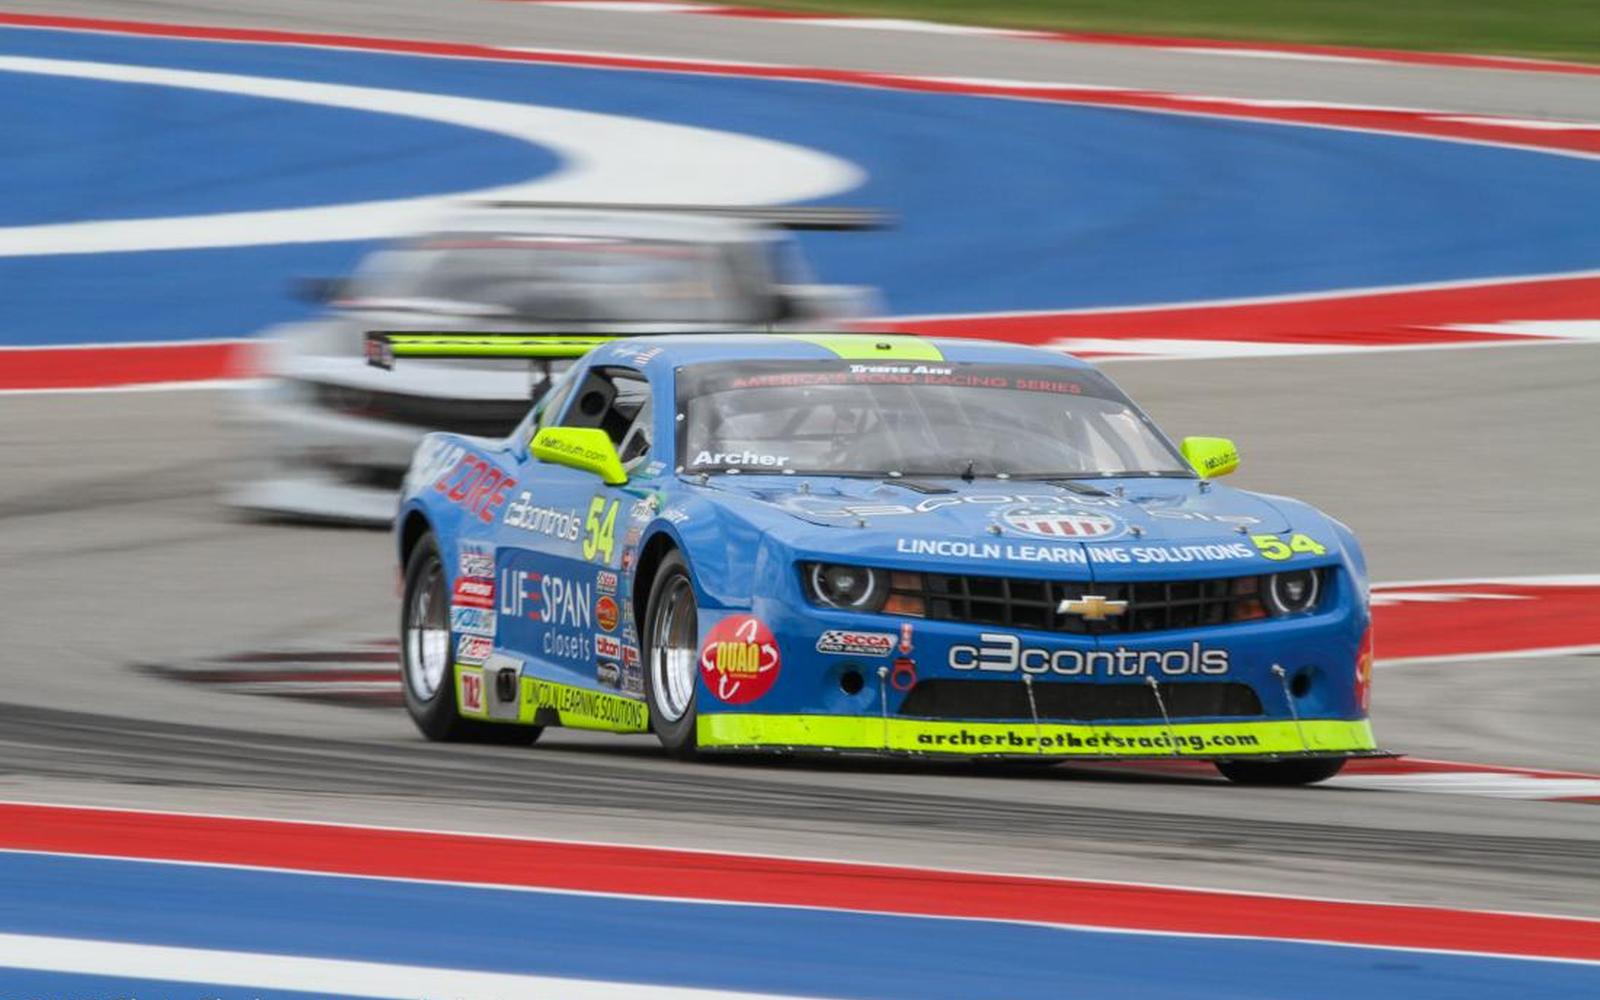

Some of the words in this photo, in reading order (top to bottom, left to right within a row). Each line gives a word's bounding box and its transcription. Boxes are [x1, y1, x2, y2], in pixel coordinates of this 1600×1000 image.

[849, 364, 903, 375] Trans
[907, 364, 953, 375] Am
[732, 374, 847, 388] AMERICA'S
[856, 374, 918, 385] ROAD
[923, 375, 1008, 388] RACING
[1016, 379, 1082, 395] SERIES
[692, 450, 789, 468] Archer
[582, 496, 620, 564] 54
[897, 538, 1000, 559] LINCOLN
[1005, 545, 1129, 564] LEARNING
[1131, 543, 1255, 563] SOLUTIONS
[1250, 534, 1327, 561] 54
[543, 628, 591, 662] closets
[820, 643, 844, 651] PRO
[843, 634, 890, 646] SCCA
[716, 641, 760, 675] QUAD
[949, 633, 1230, 676] c3controls
[559, 687, 600, 719] LEARNING
[600, 694, 643, 728] SOLUTIONS
[917, 731, 1260, 751] archerbrothersracing.com
